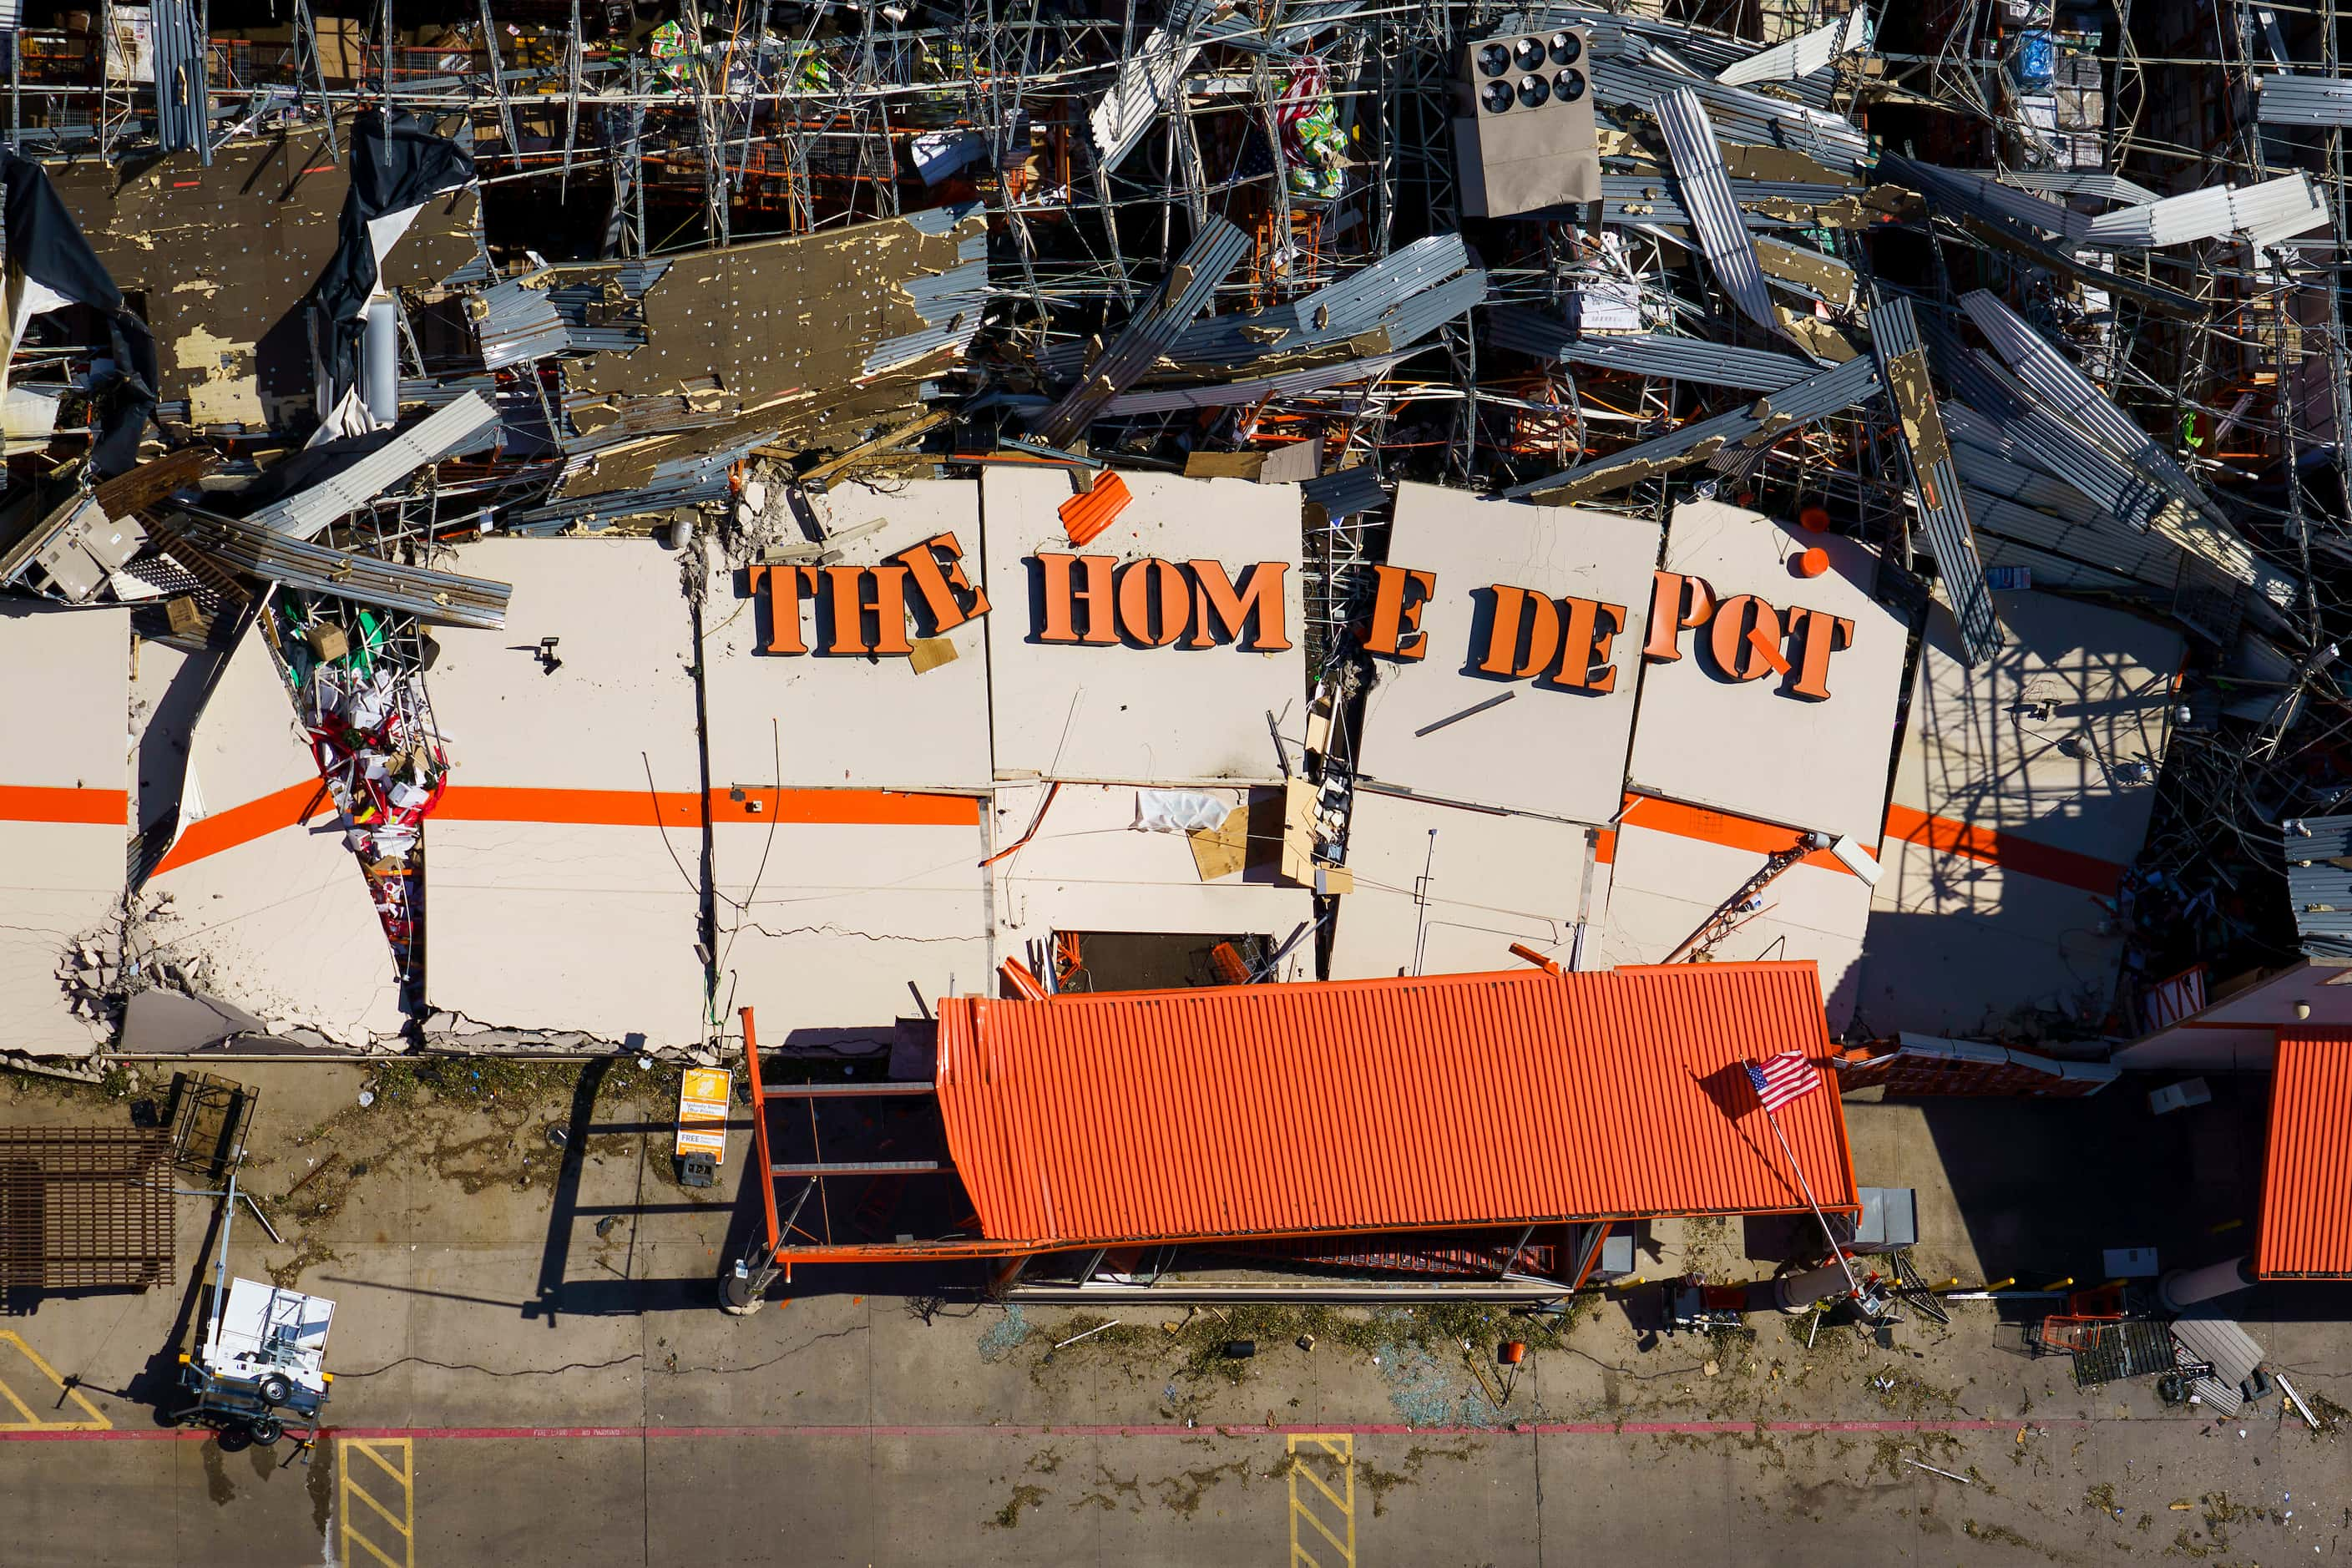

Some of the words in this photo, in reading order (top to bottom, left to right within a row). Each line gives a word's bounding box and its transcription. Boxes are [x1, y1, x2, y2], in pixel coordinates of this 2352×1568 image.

[748, 531, 992, 657] THE
[1479, 569, 1855, 702] DEPOT
[681, 1134, 700, 1143] FREE
